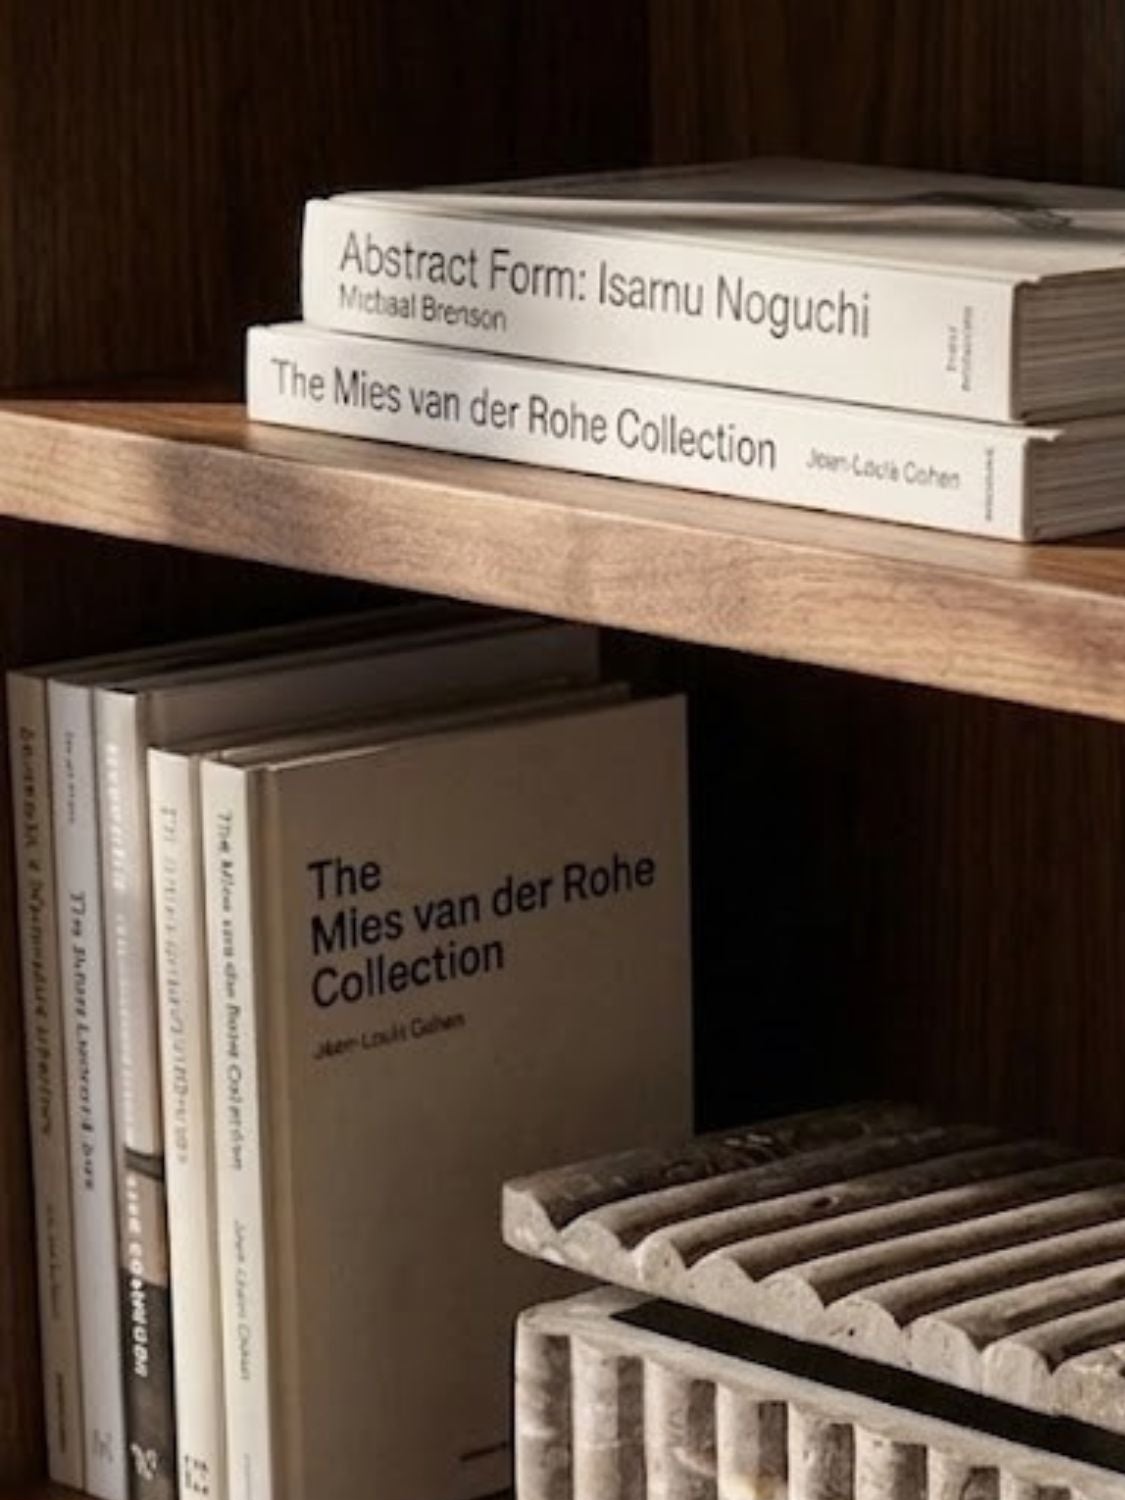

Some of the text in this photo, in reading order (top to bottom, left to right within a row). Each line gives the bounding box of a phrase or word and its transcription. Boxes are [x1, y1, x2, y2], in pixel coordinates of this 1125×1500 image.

[340, 230, 478, 289] Abstract
[490, 248, 586, 302] Form:
[717, 273, 869, 339] Noguchi
[422, 293, 507, 332] Brenson
[271, 357, 776, 470] The Mies van der Rohe Collection
[307, 857, 381, 900] The
[311, 853, 656, 955] Mies van der Rohe
[311, 940, 504, 1008] Collection
